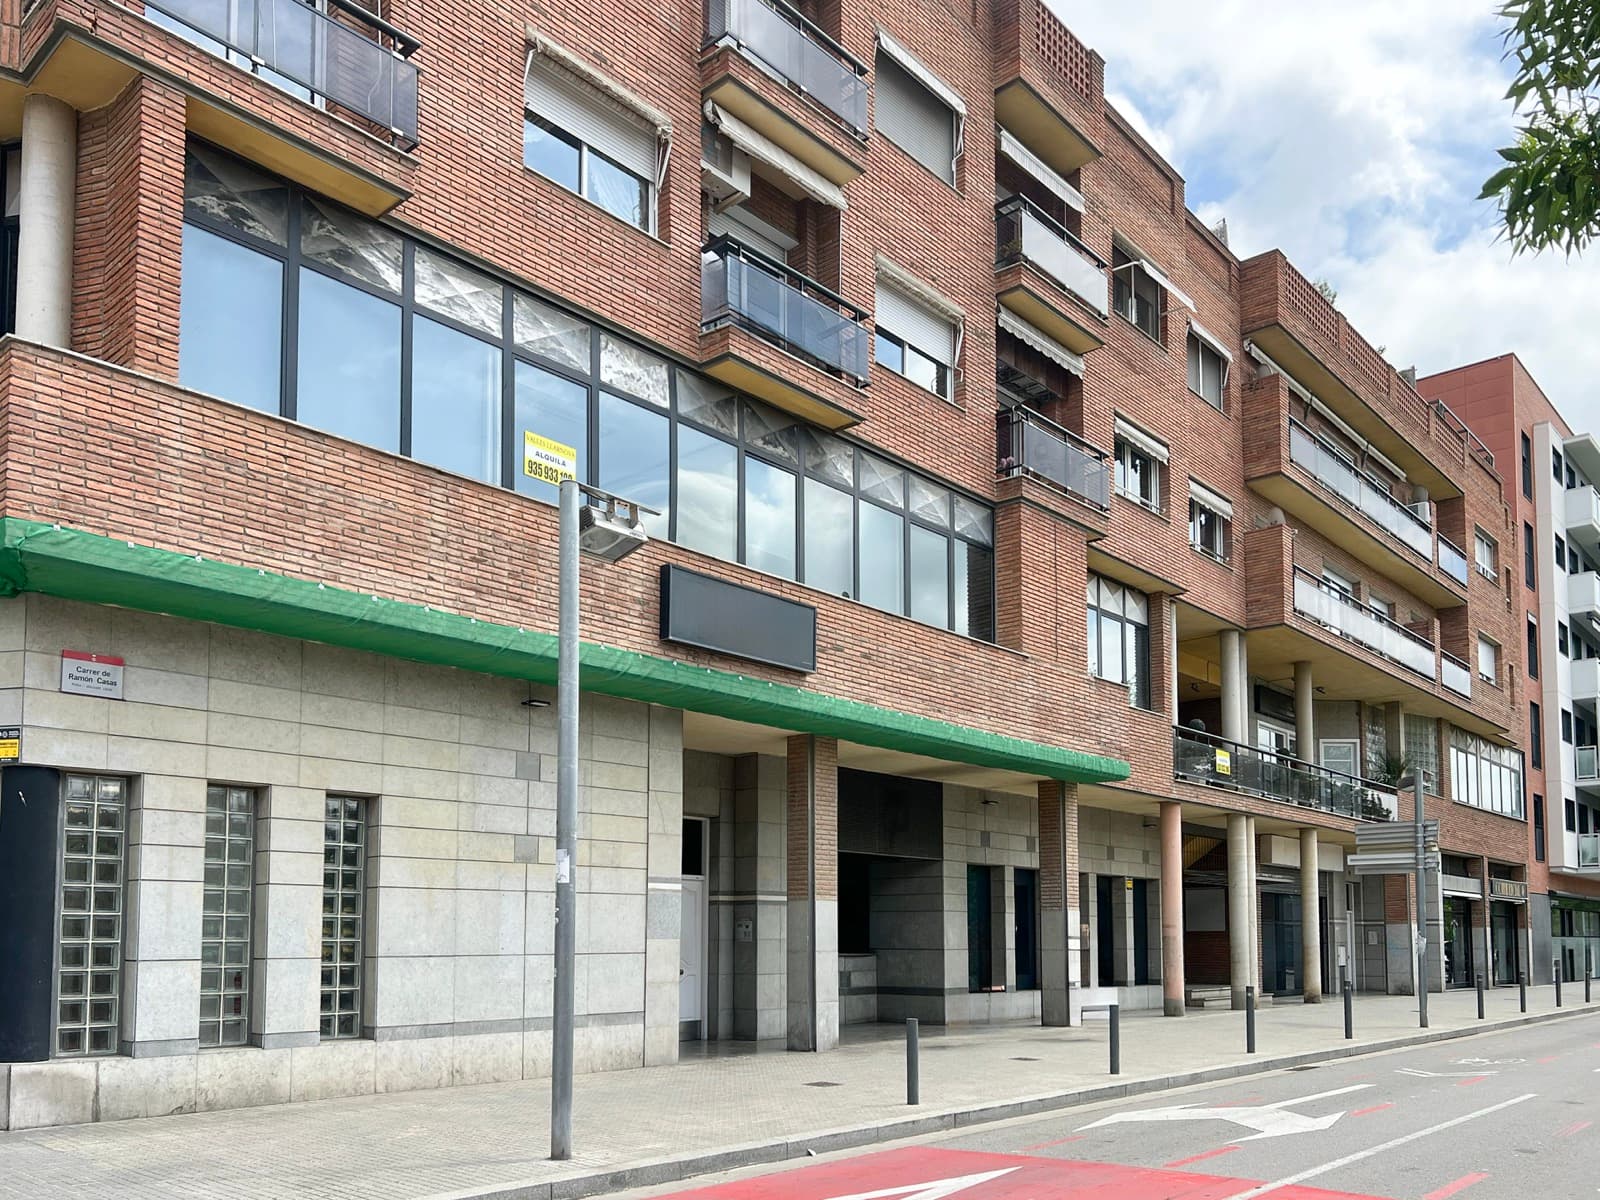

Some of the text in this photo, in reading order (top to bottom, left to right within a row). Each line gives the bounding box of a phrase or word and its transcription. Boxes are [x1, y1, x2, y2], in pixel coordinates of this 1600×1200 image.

[535, 451, 566, 467] ALQUILA
[527, 459, 543, 478] 935
[544, 465, 559, 483] 933
[76, 665, 100, 676] Carrer
[96, 677, 118, 687] Casas
